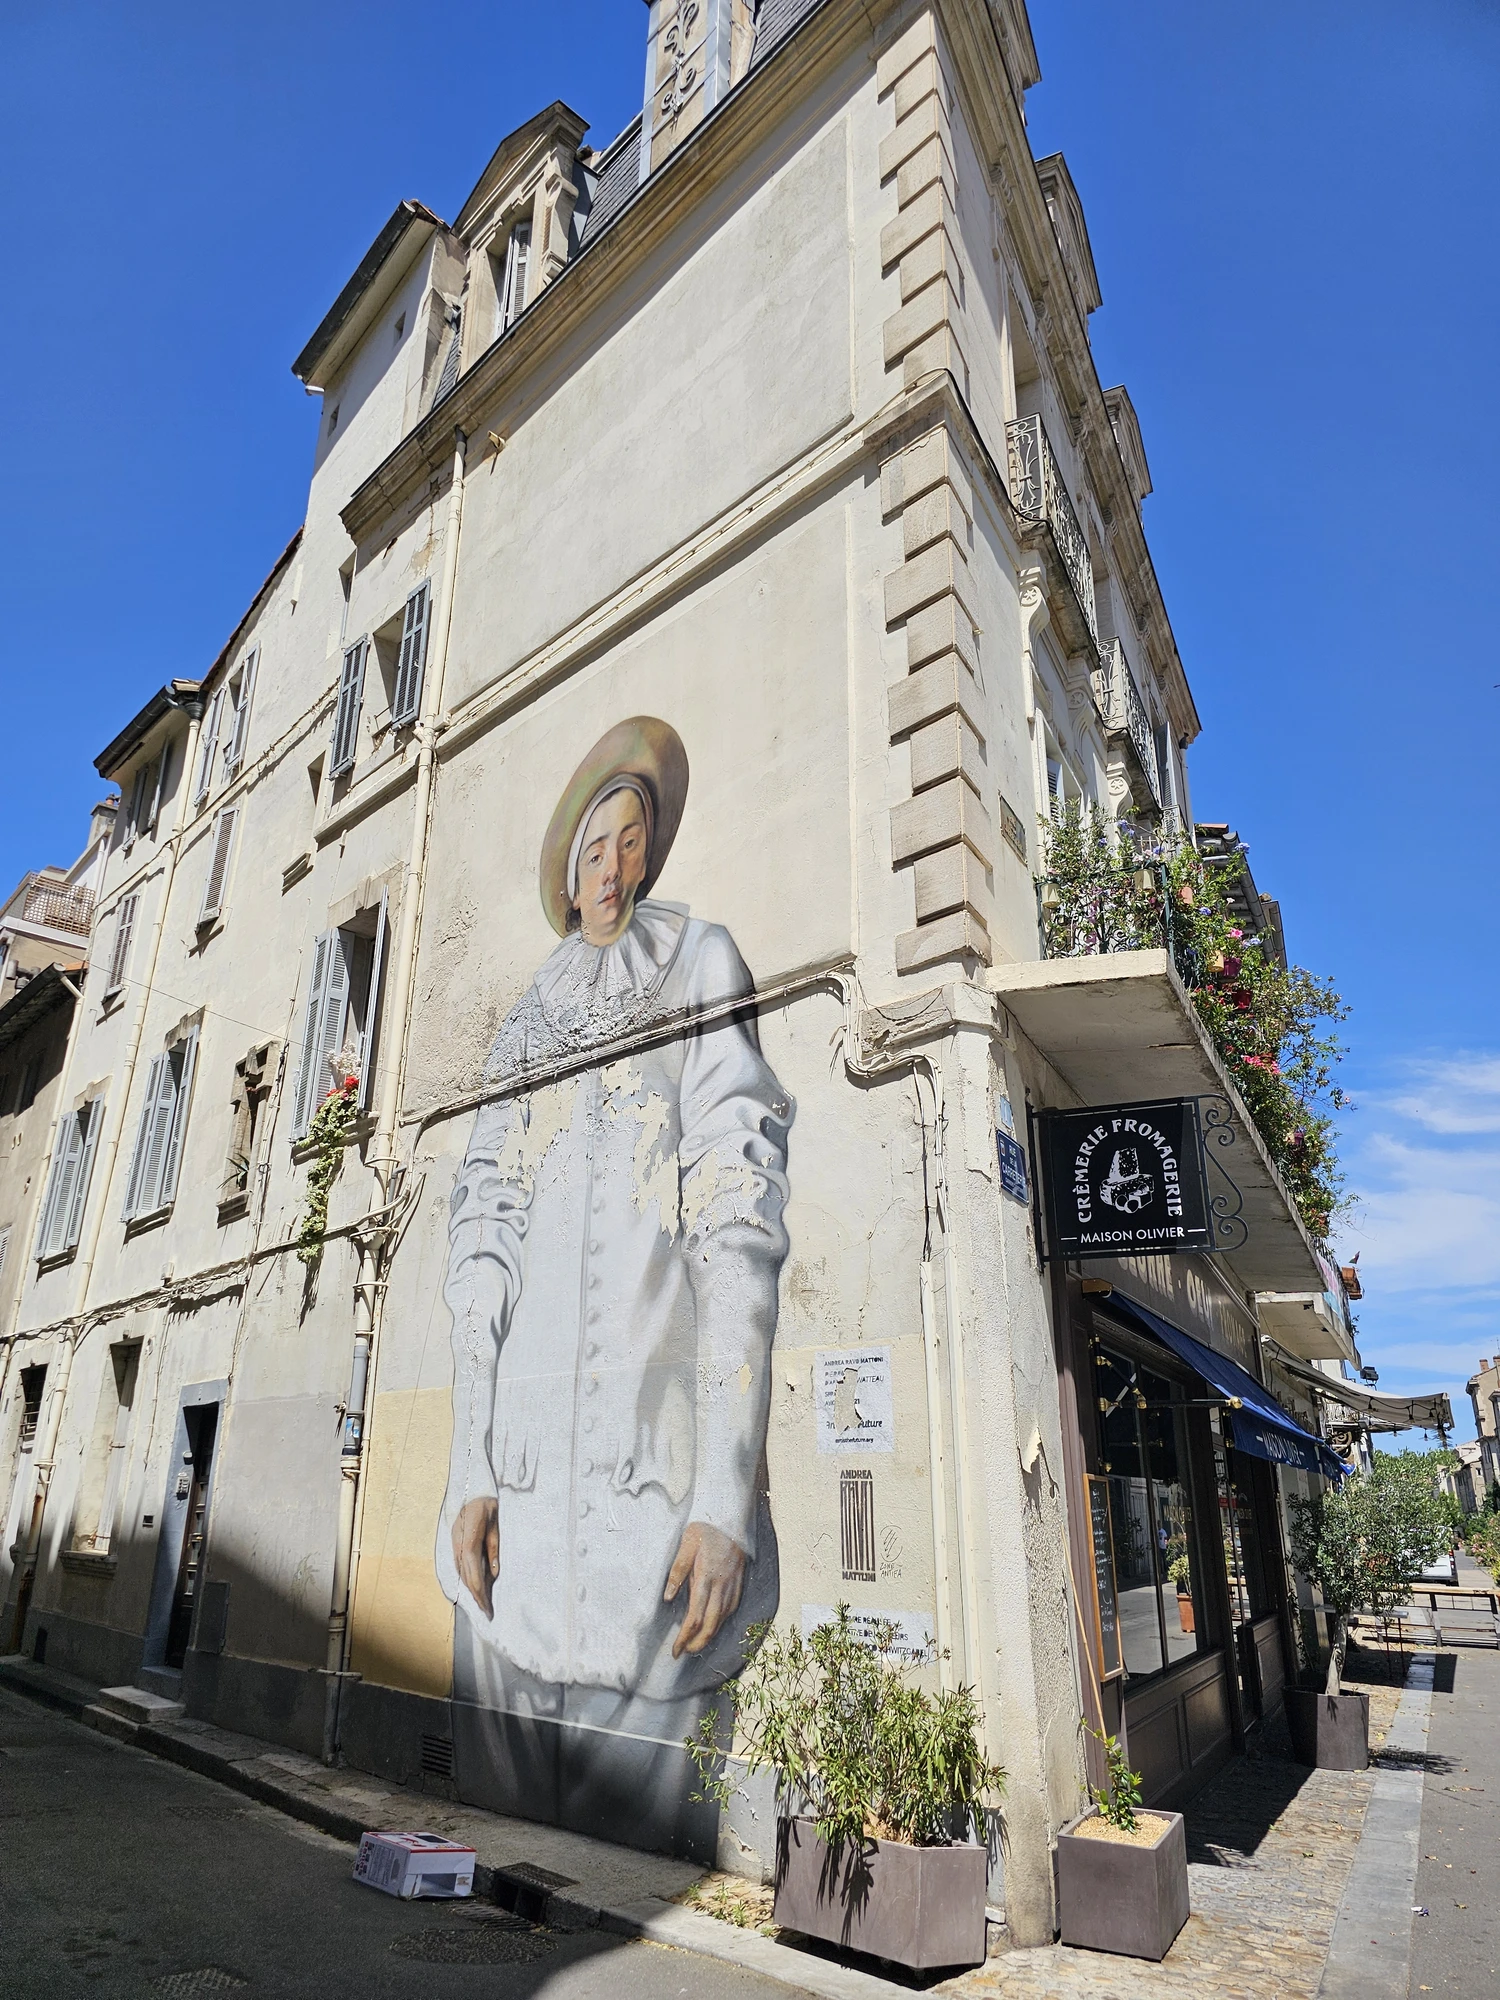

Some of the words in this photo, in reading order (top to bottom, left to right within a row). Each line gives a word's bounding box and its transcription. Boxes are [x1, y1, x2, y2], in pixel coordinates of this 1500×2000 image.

[1072, 1126, 1108, 1224] CRÈMERIE
[1111, 1118, 1183, 1217] FROMAGERIE
[1080, 1230, 1133, 1244] MAISON
[1136, 1226, 1185, 1240] OLIVIER
[840, 1469, 872, 1479] ANDREA
[842, 1571, 876, 1582] MATTONI
